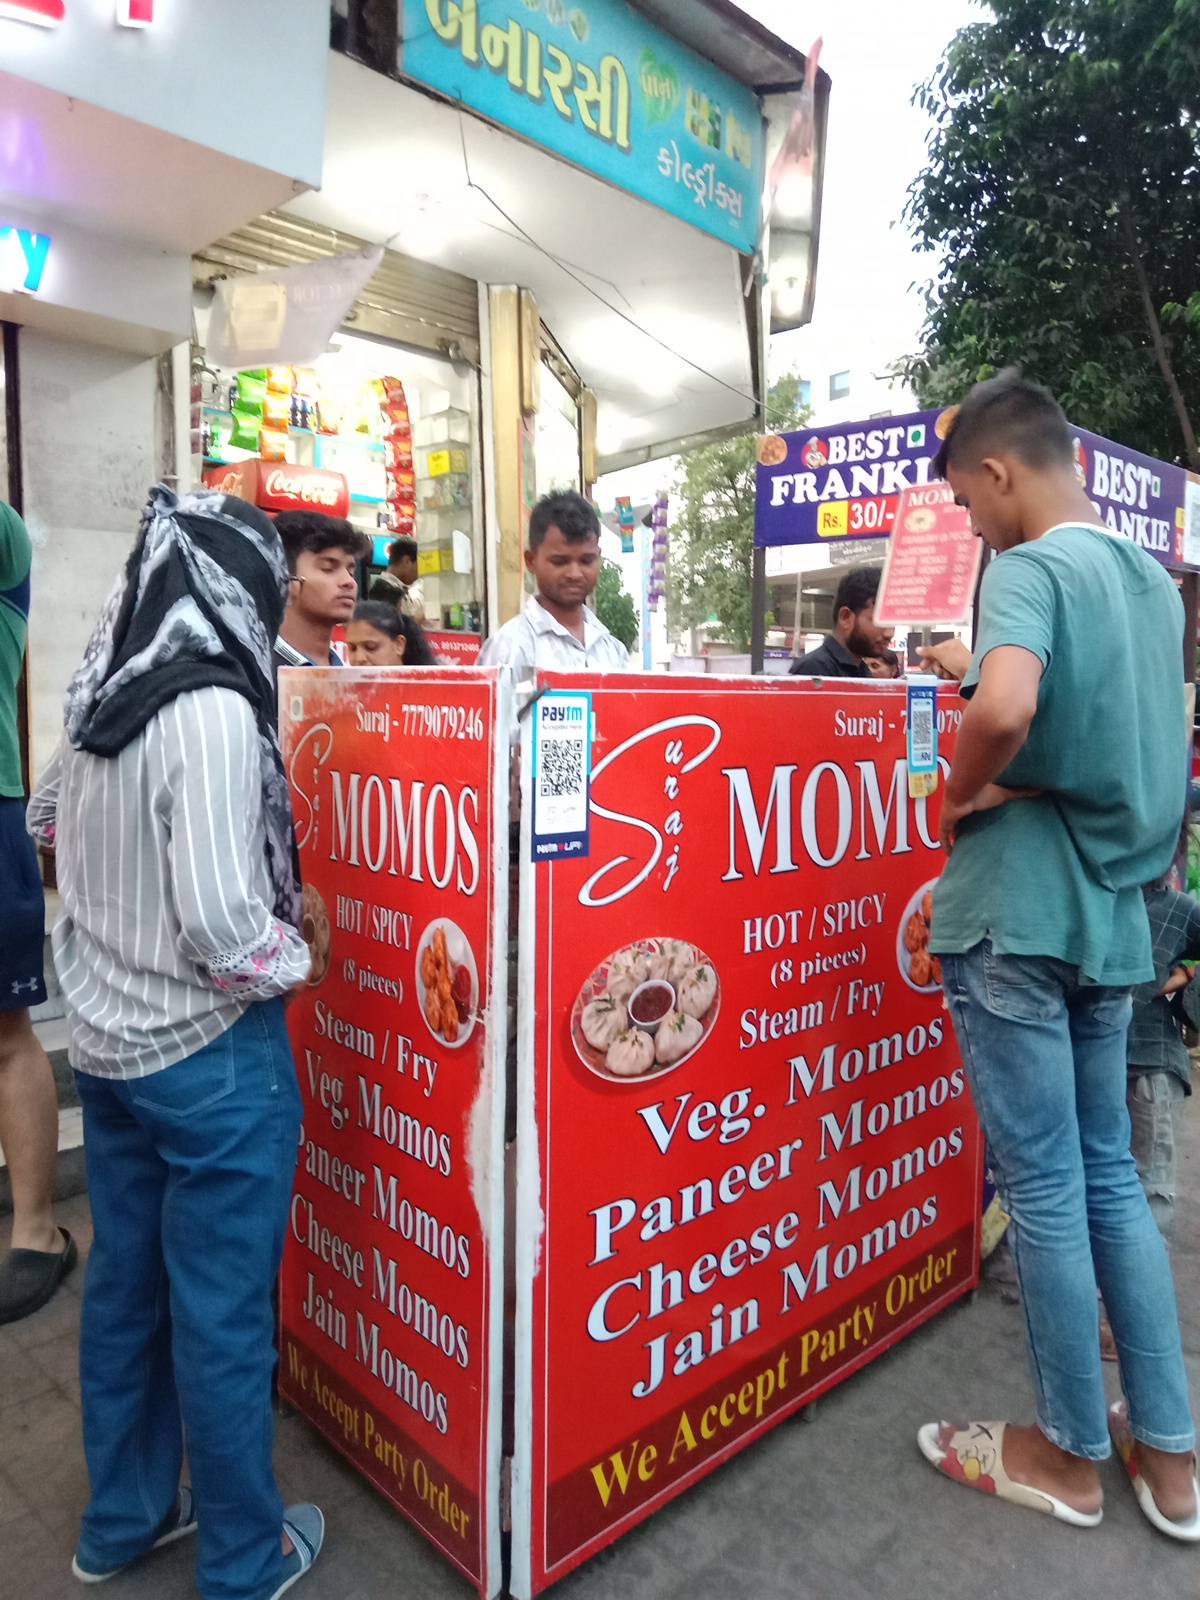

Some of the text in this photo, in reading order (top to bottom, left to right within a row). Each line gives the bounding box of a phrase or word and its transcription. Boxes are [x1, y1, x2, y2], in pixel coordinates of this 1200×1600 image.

[770, 457, 938, 506] FRANKI
[828, 427, 905, 465] BEST
[1092, 450, 1152, 510] BEST
[823, 499, 895, 530] Rs. 30/-
[908, 489, 956, 507] MOM
[1091, 501, 1171, 553] ANKIE
[357, 703, 390, 742] Suraj
[402, 704, 483, 741] 7779079246
[835, 709, 884, 743] Suraj
[329, 770, 480, 896] MOMOS
[721, 757, 951, 881] MOMO
[337, 895, 363, 934] HOT
[372, 905, 414, 951] SPICY
[743, 910, 802, 954] HOT
[823, 893, 887, 937] SPICY
[343, 958, 403, 1004] (8 pieces)
[770, 943, 867, 988] (8 pieces)
[314, 1000, 375, 1059] Steam
[397, 1034, 438, 1097] Fry
[739, 999, 823, 1050] Steam
[847, 979, 886, 1017] Fry
[305, 1049, 451, 1177] Veg. Momos
[637, 1017, 944, 1156] Veg. Momos
[588, 1067, 965, 1268] Paneer Momos
[372, 1165, 470, 1279] Momos
[586, 1124, 963, 1343] Cheese Momos
[291, 1193, 470, 1368] Cheese Momos
[631, 1195, 938, 1399] Jain Momos
[303, 1272, 448, 1434] Jain Momos
[590, 1248, 958, 1508] We Accept Party Order
[287, 1342, 470, 1539] We Accept Party Order
